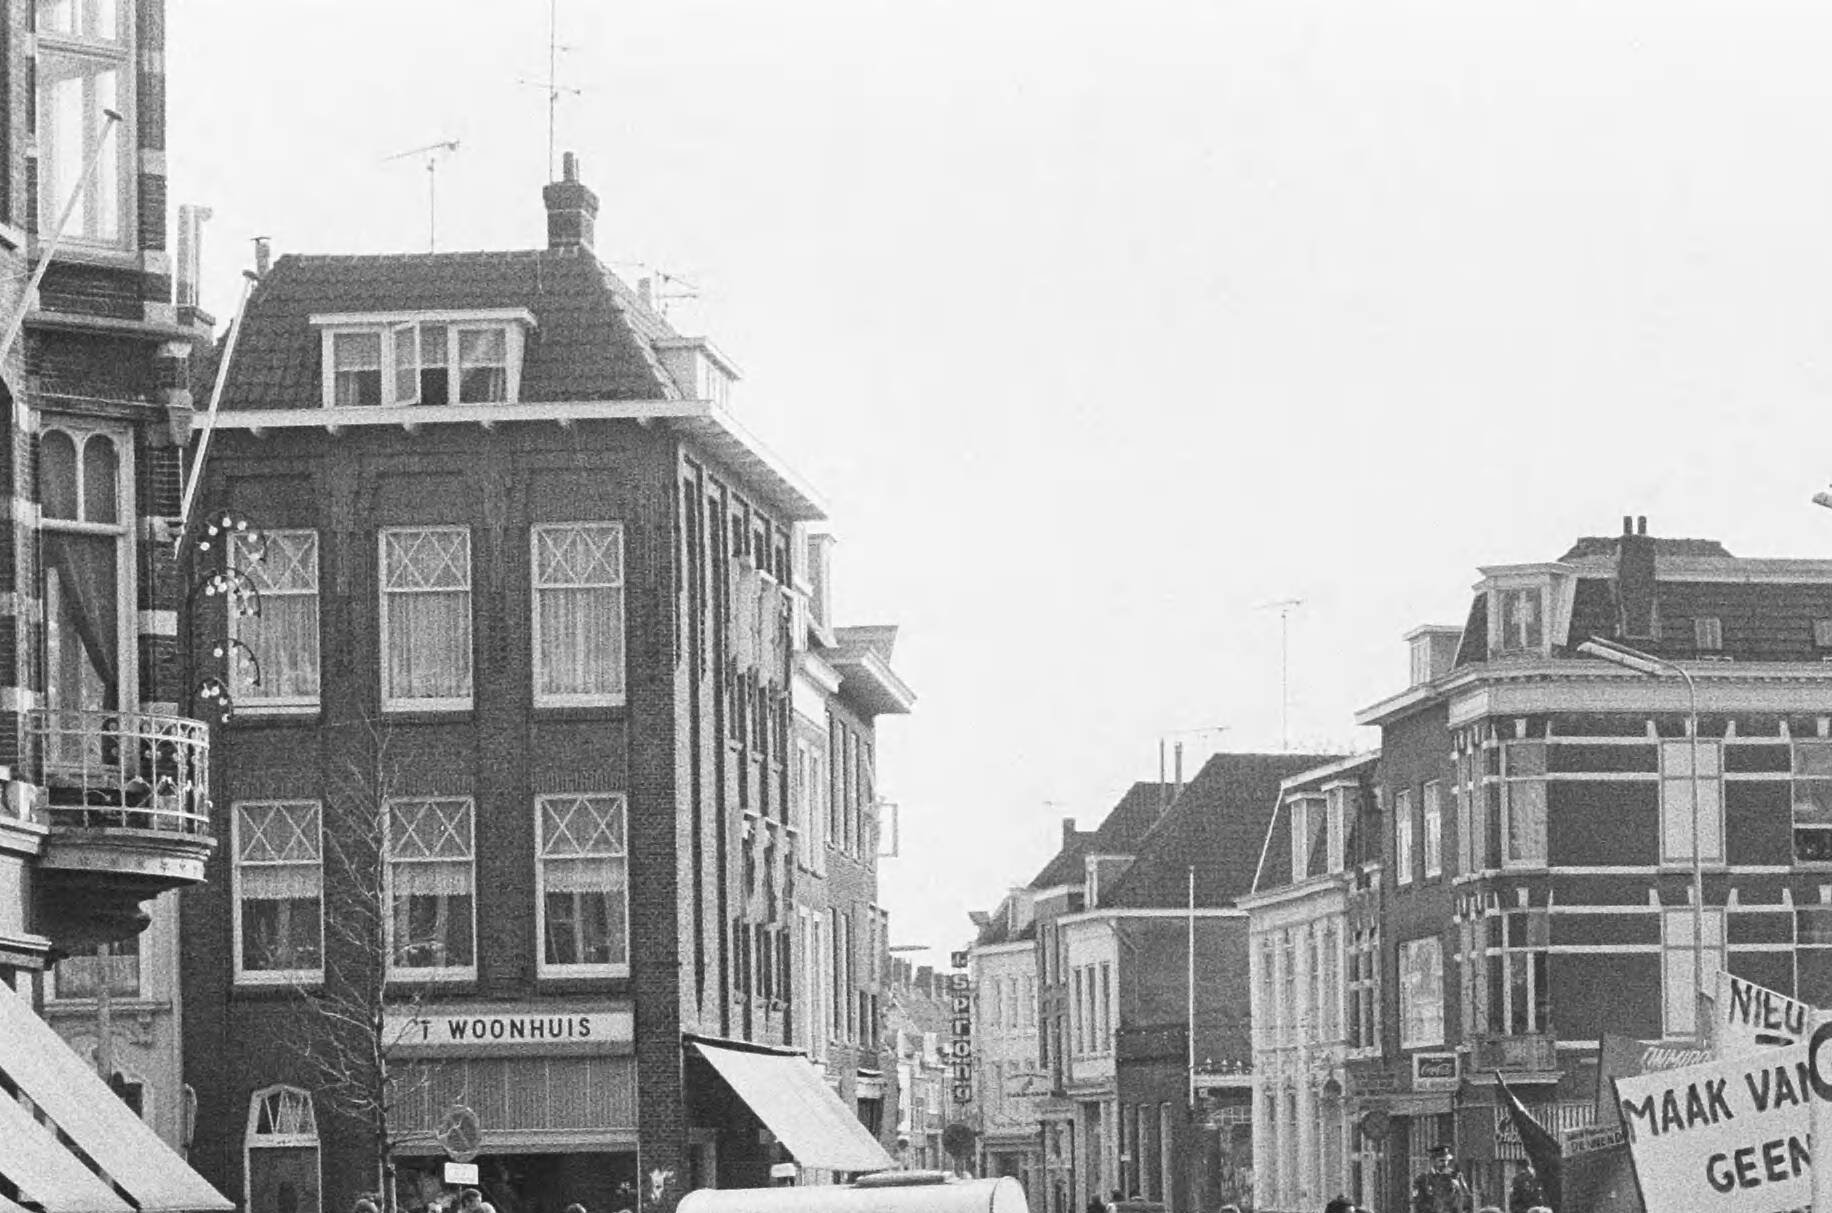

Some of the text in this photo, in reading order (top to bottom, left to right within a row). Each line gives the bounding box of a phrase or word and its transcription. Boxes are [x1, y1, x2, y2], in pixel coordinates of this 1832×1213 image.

[448, 1017, 592, 1040] WOONHUIS
[1622, 1076, 1735, 1145] MAAK
[1706, 1133, 1811, 1193] GEEN
